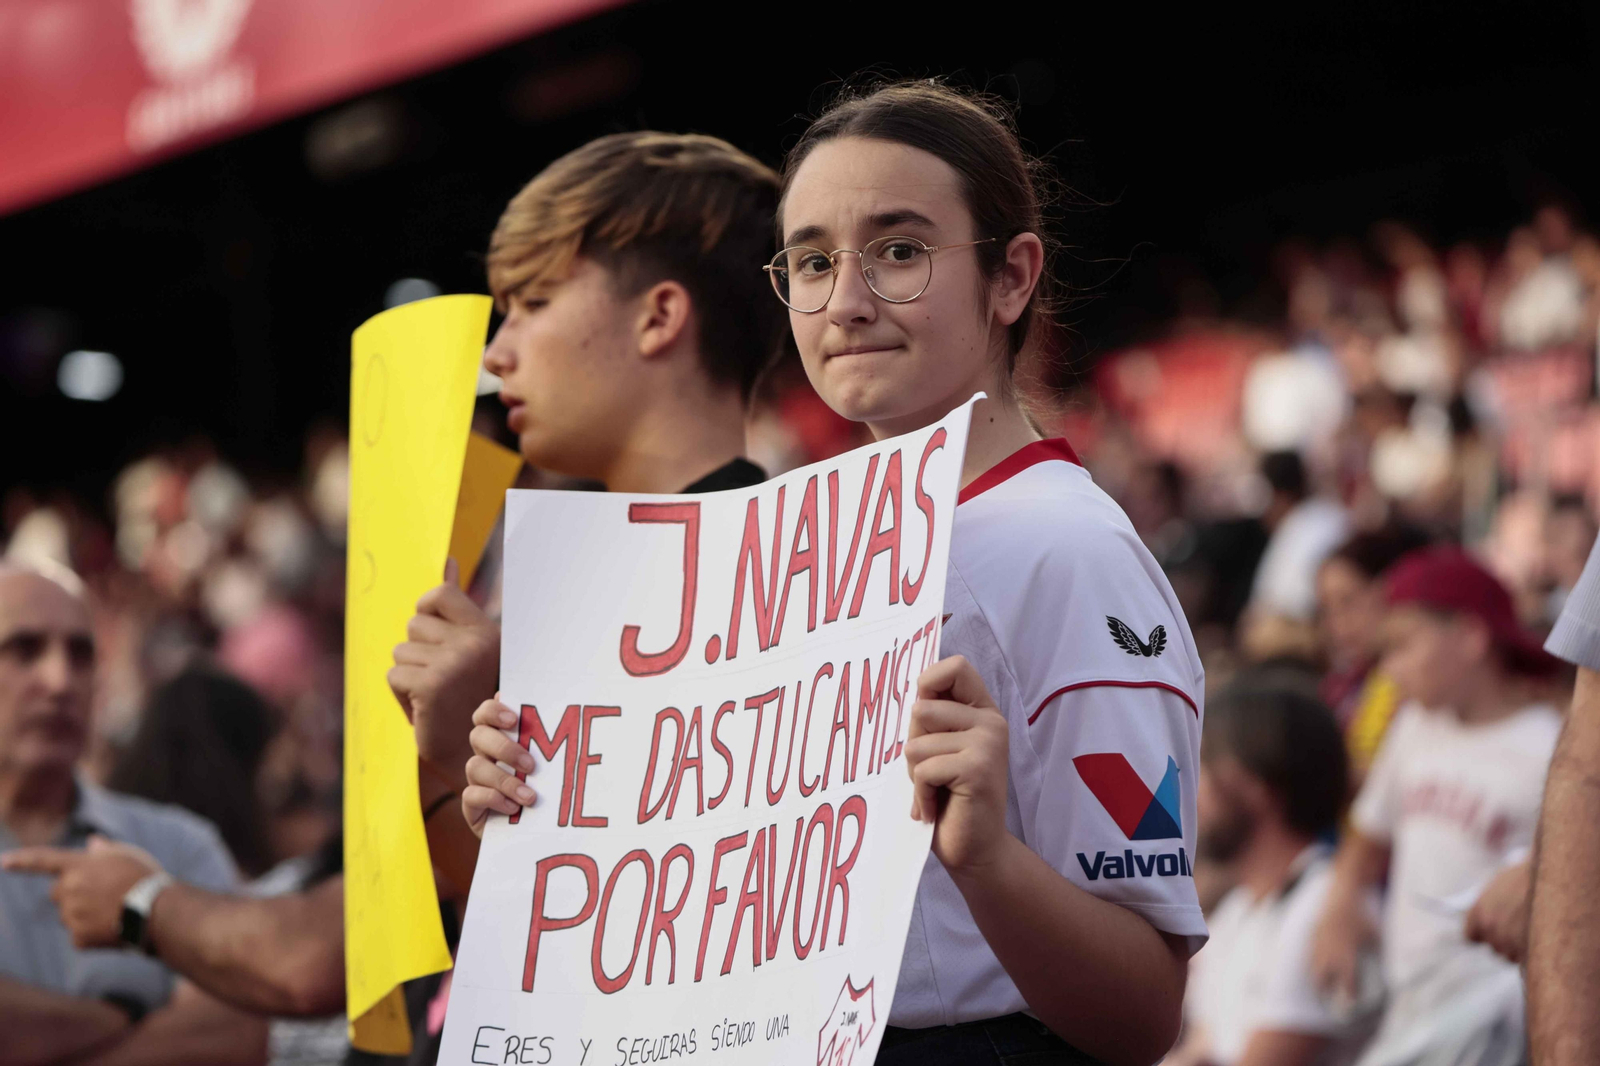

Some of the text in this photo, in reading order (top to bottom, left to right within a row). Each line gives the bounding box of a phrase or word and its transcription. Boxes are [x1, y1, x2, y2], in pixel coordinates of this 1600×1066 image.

[508, 703, 621, 828] ME
[522, 794, 867, 994] POR FAVOR
[471, 1025, 555, 1066] ERES
[579, 1037, 593, 1066] Y
[614, 1028, 698, 1066] SEGUIRAS
[766, 1013, 789, 1040] UNA
